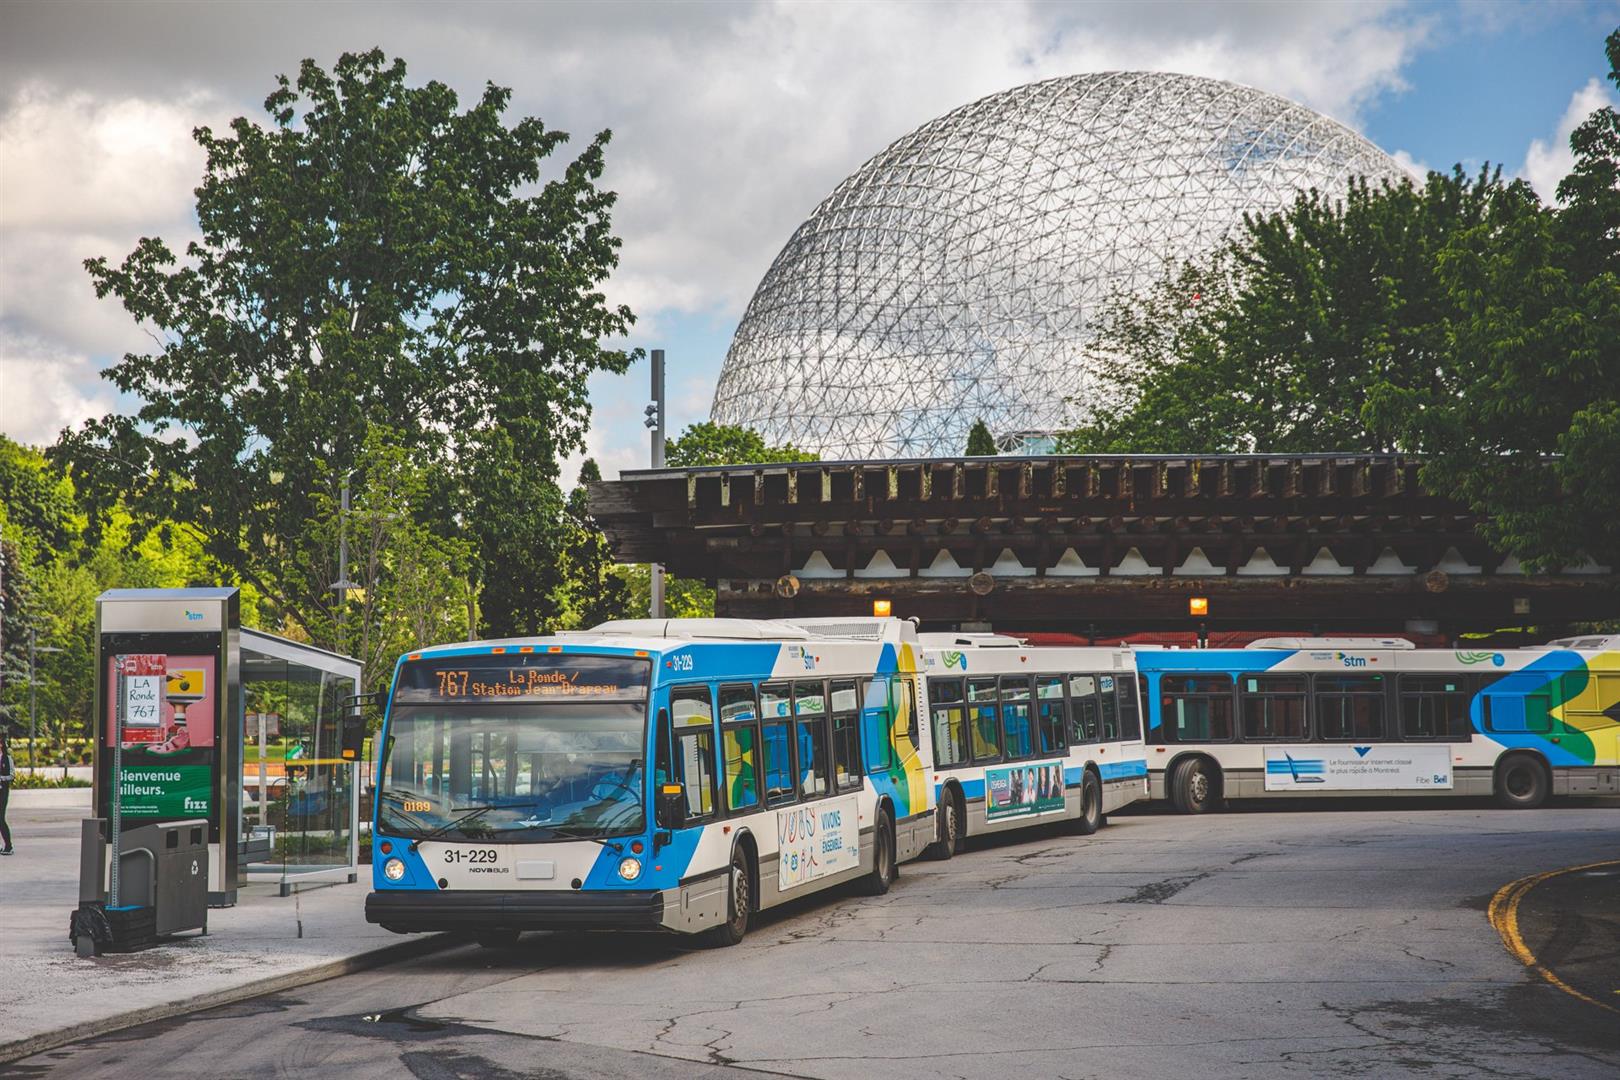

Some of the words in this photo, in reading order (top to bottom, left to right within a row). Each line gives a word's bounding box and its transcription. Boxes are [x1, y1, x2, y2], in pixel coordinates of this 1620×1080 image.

[188, 612, 204, 620] stm
[672, 654, 693, 671] 31-229
[1344, 656, 1366, 667] stm
[134, 678, 150, 689] LA
[509, 670, 525, 684] La
[529, 670, 567, 684] Ronde
[436, 671, 469, 697] 767
[472, 682, 521, 696] Station
[525, 681, 617, 696] Jean-Drapeau
[129, 689, 156, 701] Ronde
[130, 705, 156, 718] 767
[1433, 775, 1447, 784] Bell
[184, 796, 208, 810] fizz
[404, 801, 431, 812] 0189
[444, 849, 498, 863] 31-229
